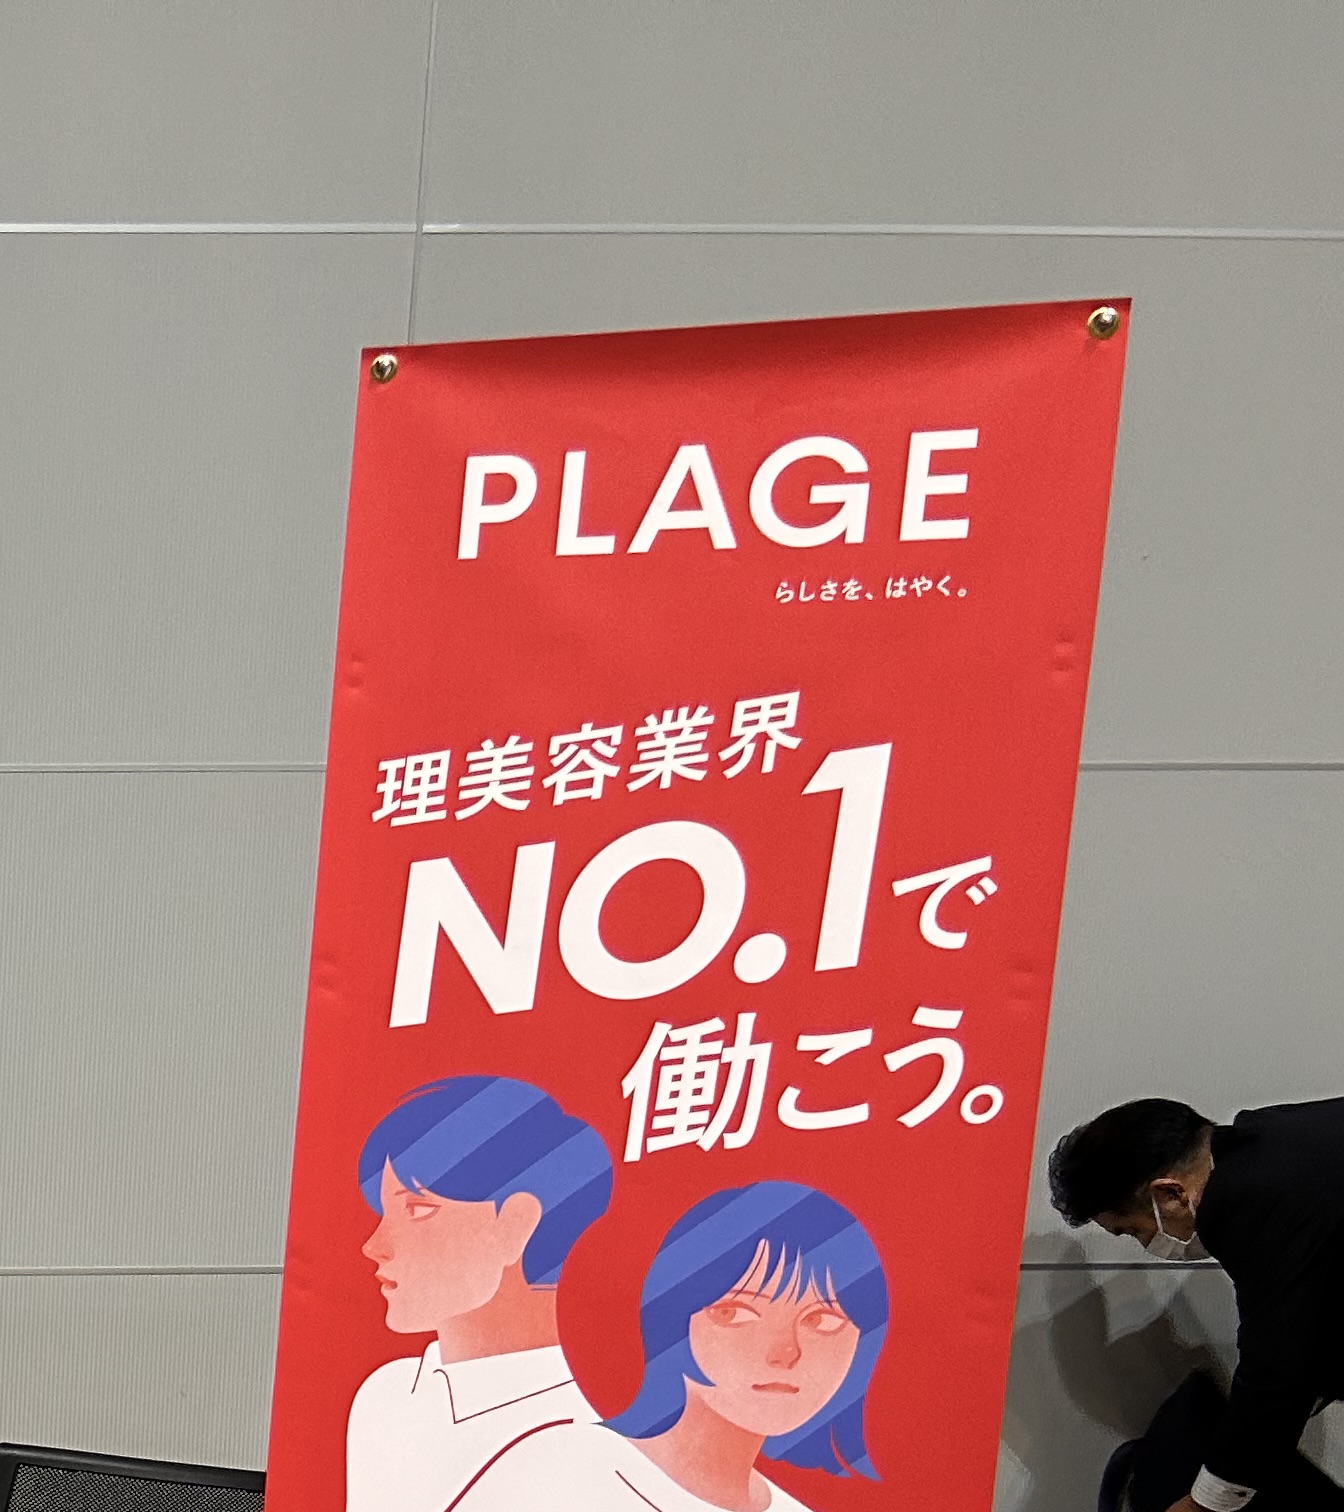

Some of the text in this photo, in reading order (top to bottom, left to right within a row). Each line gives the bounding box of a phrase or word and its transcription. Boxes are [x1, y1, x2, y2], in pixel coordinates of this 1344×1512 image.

[457, 428, 979, 560] PLAGE
[776, 575, 968, 604] らしさを、はやく。
[371, 690, 803, 828] 理美容業界
[389, 742, 997, 1028] NO.1で
[622, 1007, 1004, 1163] 働こう。
